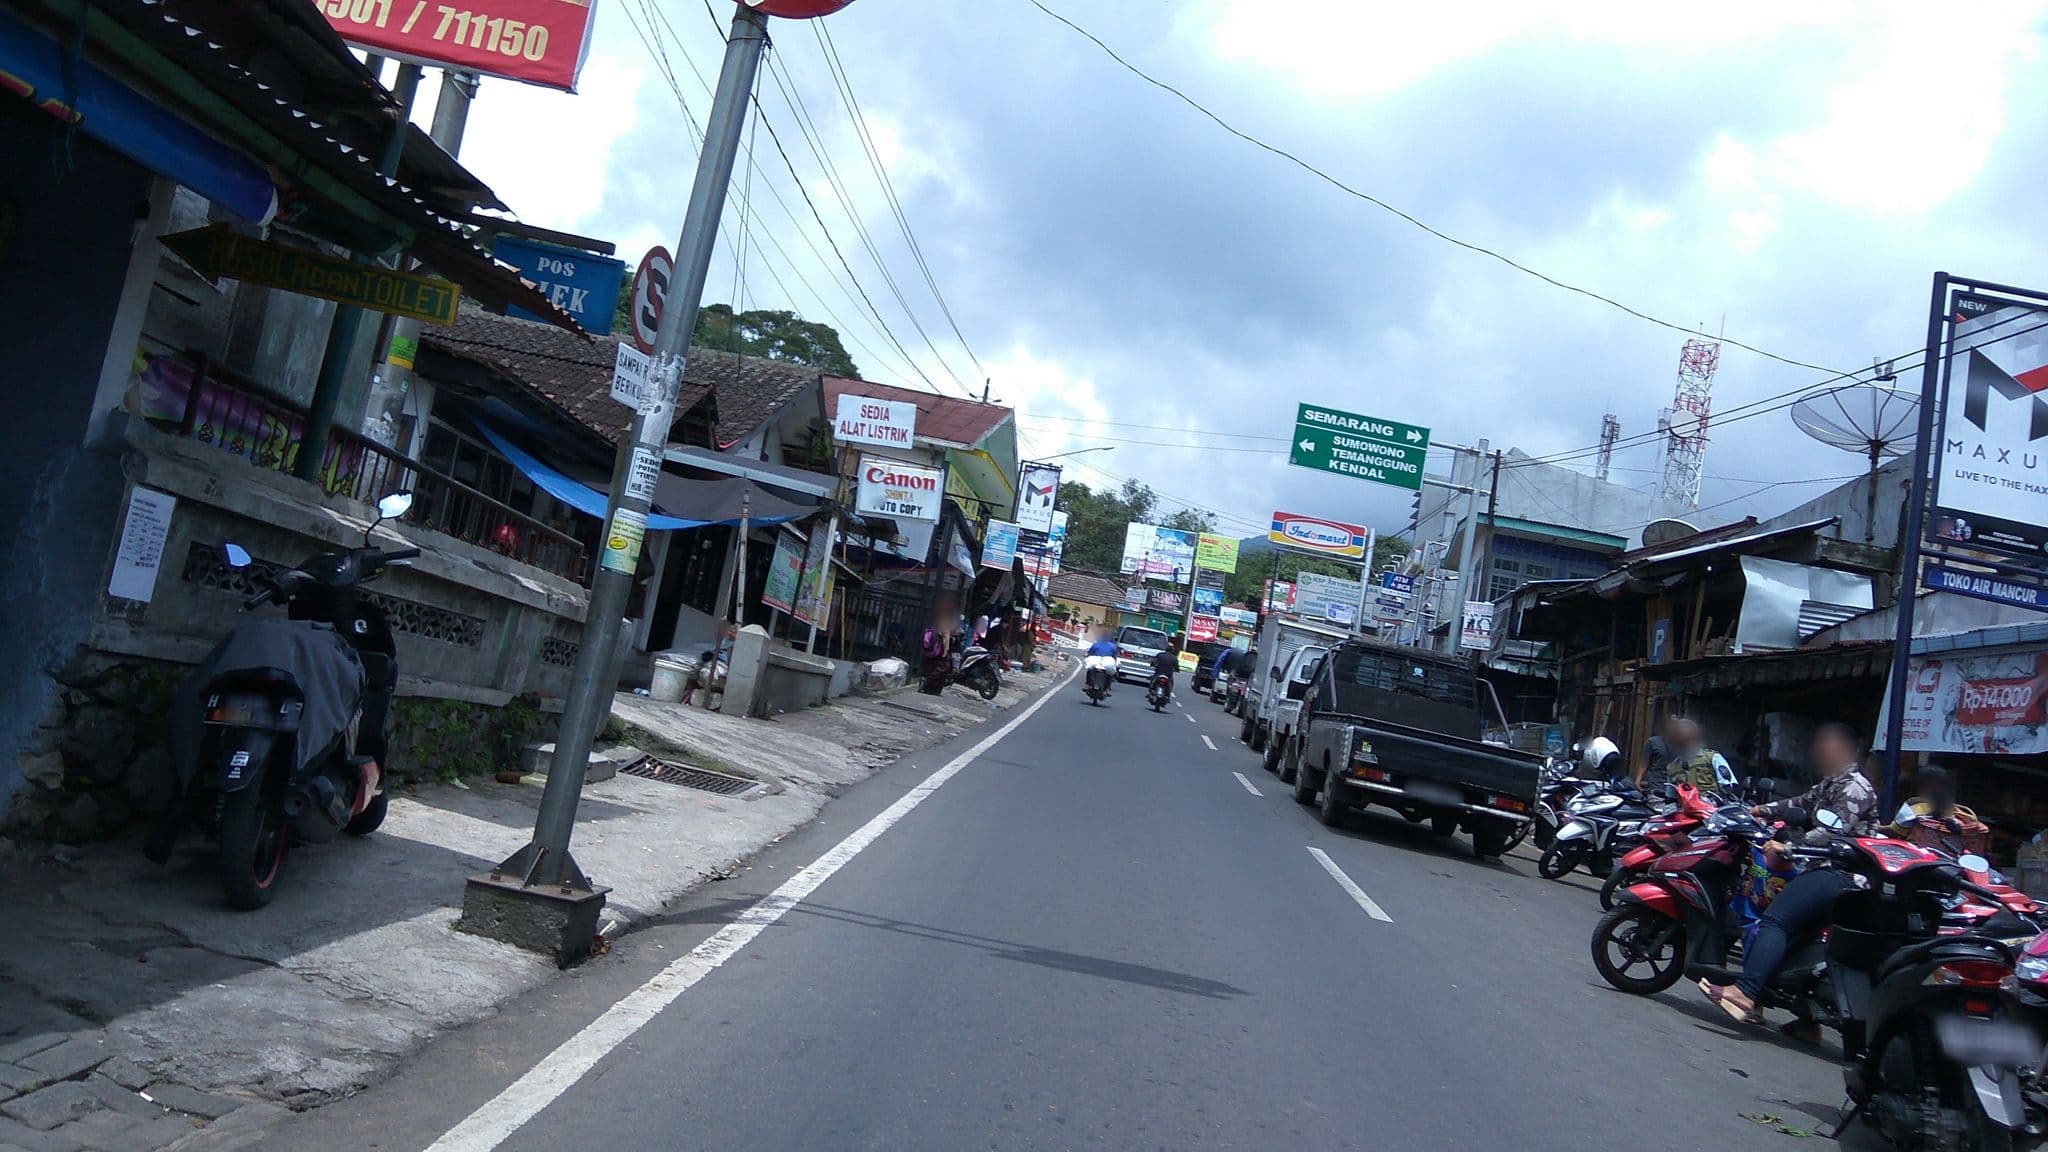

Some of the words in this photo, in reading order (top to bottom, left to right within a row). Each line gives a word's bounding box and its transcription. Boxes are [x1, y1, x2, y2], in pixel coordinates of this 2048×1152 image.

[433, 6, 549, 62] 711150
[537, 257, 576, 277] POS
[362, 270, 451, 319] TOILET
[1958, 300, 1987, 312] NEW
[618, 352, 643, 377] SAMPAI
[615, 375, 643, 400] BERIKU
[860, 404, 890, 421] SEDIA
[1304, 409, 1394, 437] SEMARANG
[840, 420, 866, 437] ALAT
[868, 424, 908, 442] LISTRIK
[1333, 436, 1405, 459] SUMOWONO
[1946, 439, 2048, 470] MAXU
[1328, 460, 1386, 480] KENDAL
[1331, 448, 1417, 474] TEMANGGUNG
[866, 468, 936, 491] Canon
[1955, 469, 1980, 482] LIVE
[1983, 475, 1997, 485] TO
[2000, 478, 2022, 490] THE
[900, 504, 923, 516] COPY
[1288, 526, 1347, 545] Indomaret
[1393, 576, 1409, 584] ATM
[1943, 571, 1970, 590] TOKO
[1972, 578, 1990, 595] AIR
[1992, 582, 2037, 603] MANCUR
[1151, 589, 1183, 602] SUSAN
[1381, 607, 1398, 615] ATM
